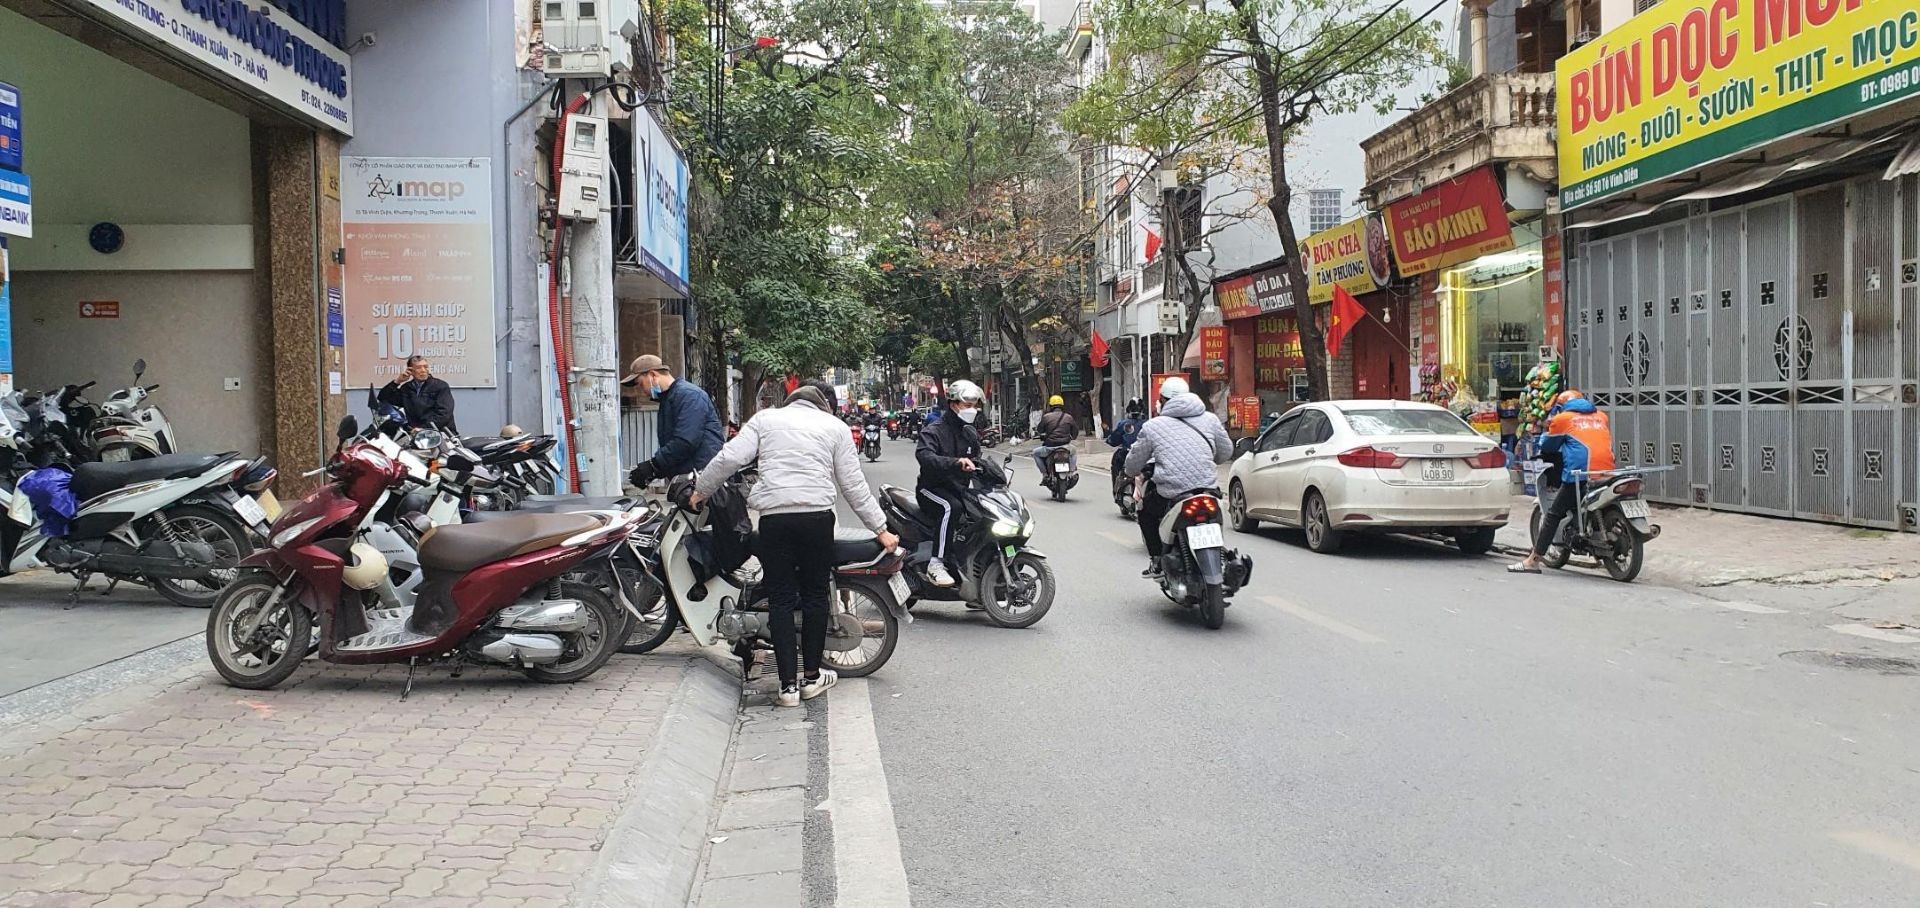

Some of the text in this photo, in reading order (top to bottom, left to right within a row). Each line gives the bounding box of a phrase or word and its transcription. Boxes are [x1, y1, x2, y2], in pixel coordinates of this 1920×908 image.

[137, 1, 165, 28] TRUNG
[1570, 41, 1641, 135] BÚN
[1652, 0, 1738, 98] DỌC
[1582, 132, 1626, 172] MÓNG
[1641, 107, 1681, 149] ĐUÔI
[1699, 78, 1754, 126] SƯỜN
[1775, 48, 1827, 95] THỊT
[1852, 11, 1918, 68] MỌC
[1861, 80, 1878, 103] ĐT:
[1880, 70, 1909, 97] 0989
[397, 180, 464, 200] imap
[1313, 224, 1361, 265] BÚN CHẢ
[1403, 204, 1488, 254] BẢO MINH
[1332, 259, 1365, 282] PHƯƠNG
[372, 300, 466, 320] SỨ MỆNH GIÚP
[372, 322, 414, 360] 10
[418, 321, 466, 347] TRIỆU
[1429, 459, 1446, 469] 30E
